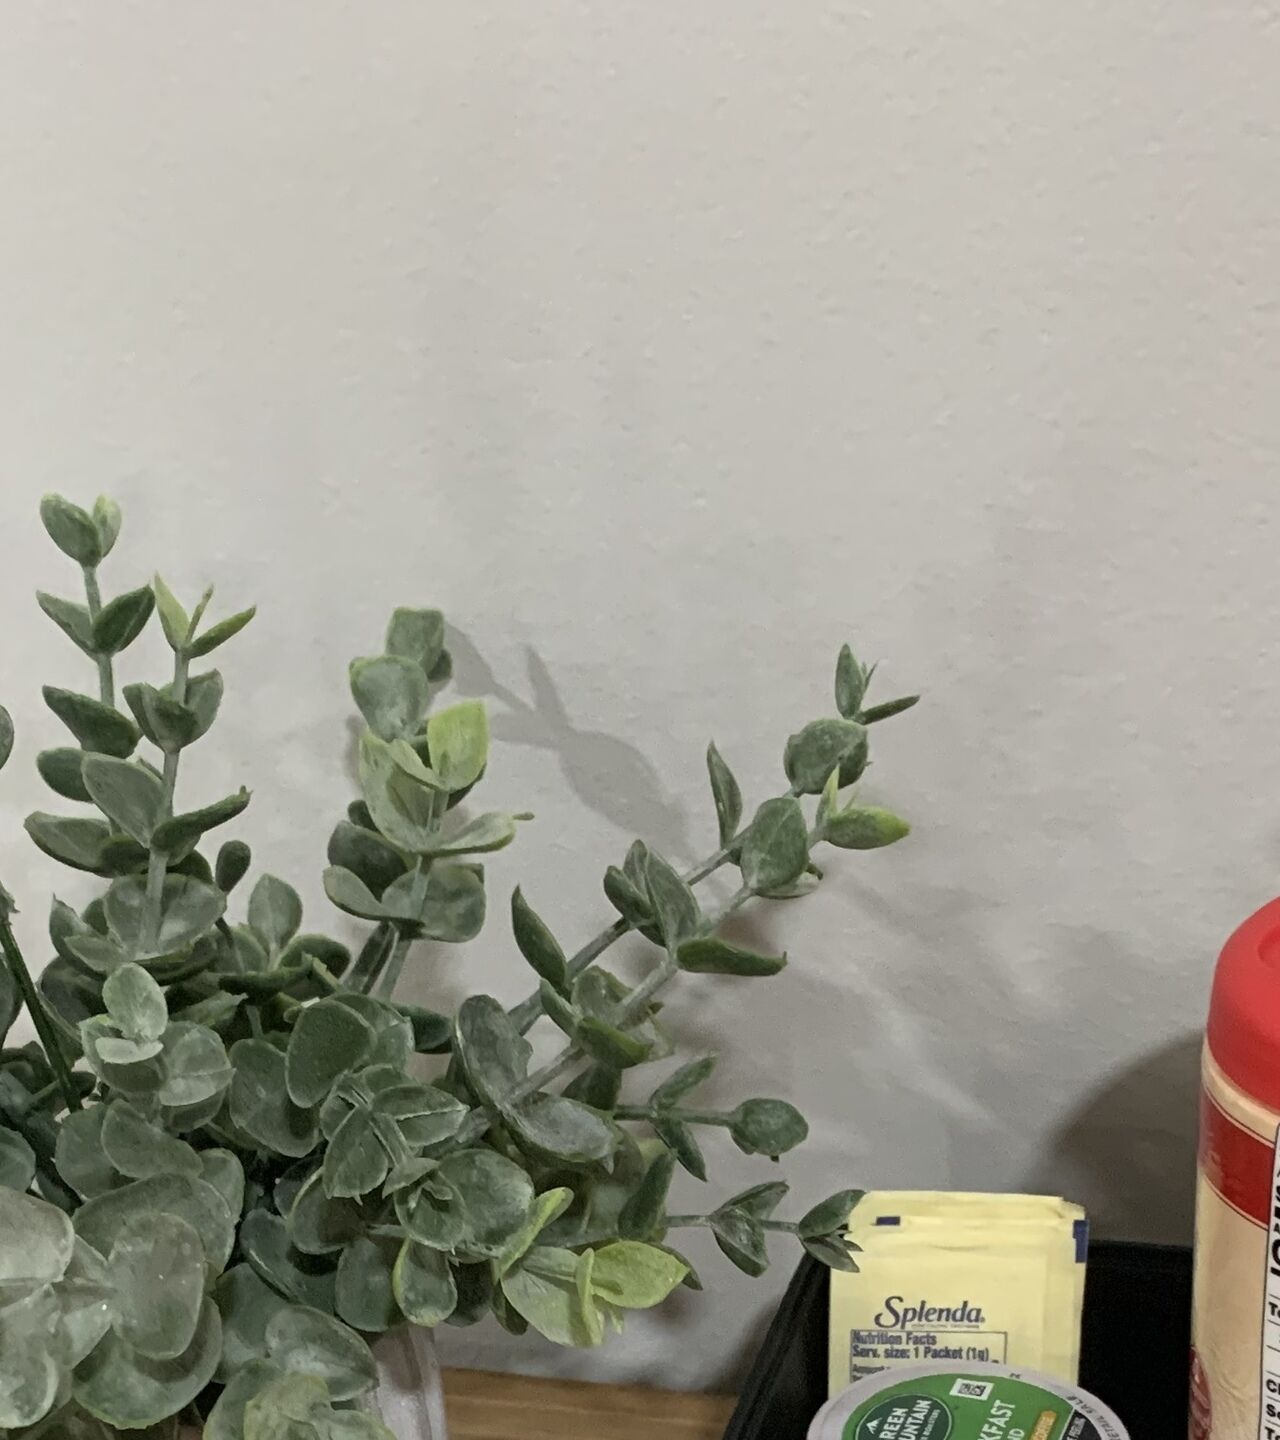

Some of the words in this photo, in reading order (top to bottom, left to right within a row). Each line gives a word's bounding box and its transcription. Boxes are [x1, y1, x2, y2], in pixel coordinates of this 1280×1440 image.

[875, 1296, 981, 1329] Splenda
[852, 1331, 902, 1345] Nutrition
[906, 1333, 937, 1346] Facts
[884, 1346, 910, 1358] size:
[914, 1347, 919, 1358] 1
[924, 1347, 962, 1360] Packet
